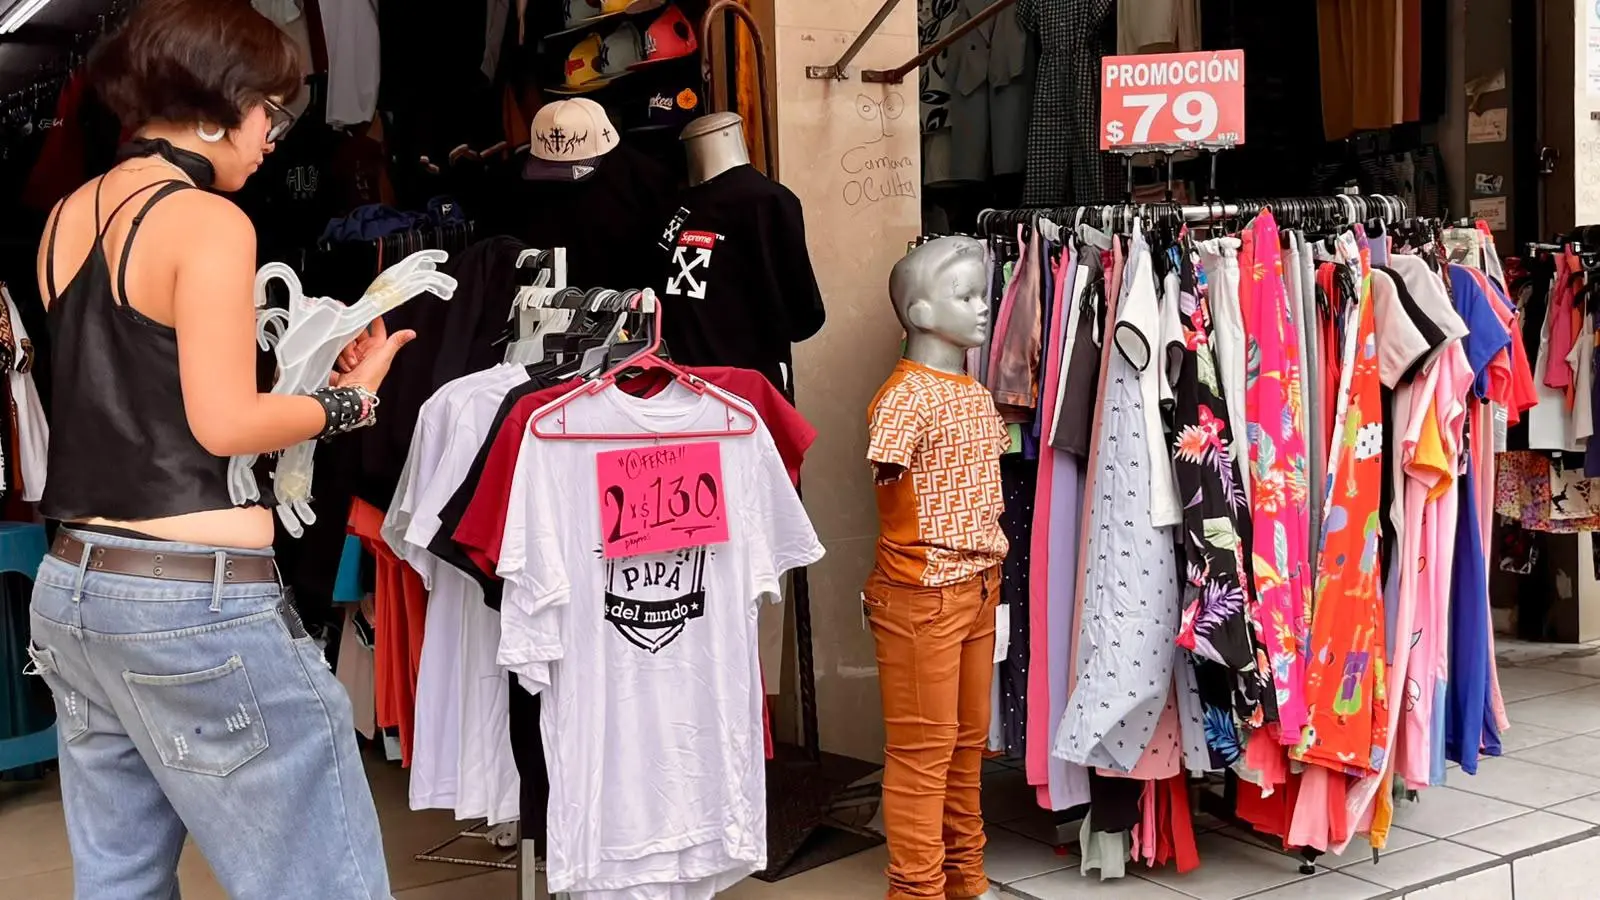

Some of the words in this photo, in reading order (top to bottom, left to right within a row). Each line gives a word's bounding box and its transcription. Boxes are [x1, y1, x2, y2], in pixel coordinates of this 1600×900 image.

[1106, 54, 1239, 88] PROMOCIÓN
[1105, 91, 1218, 144] $79
[841, 146, 912, 174] Camara
[605, 485, 638, 543] 2
[611, 601, 640, 621] del
[643, 603, 688, 623] mundo
